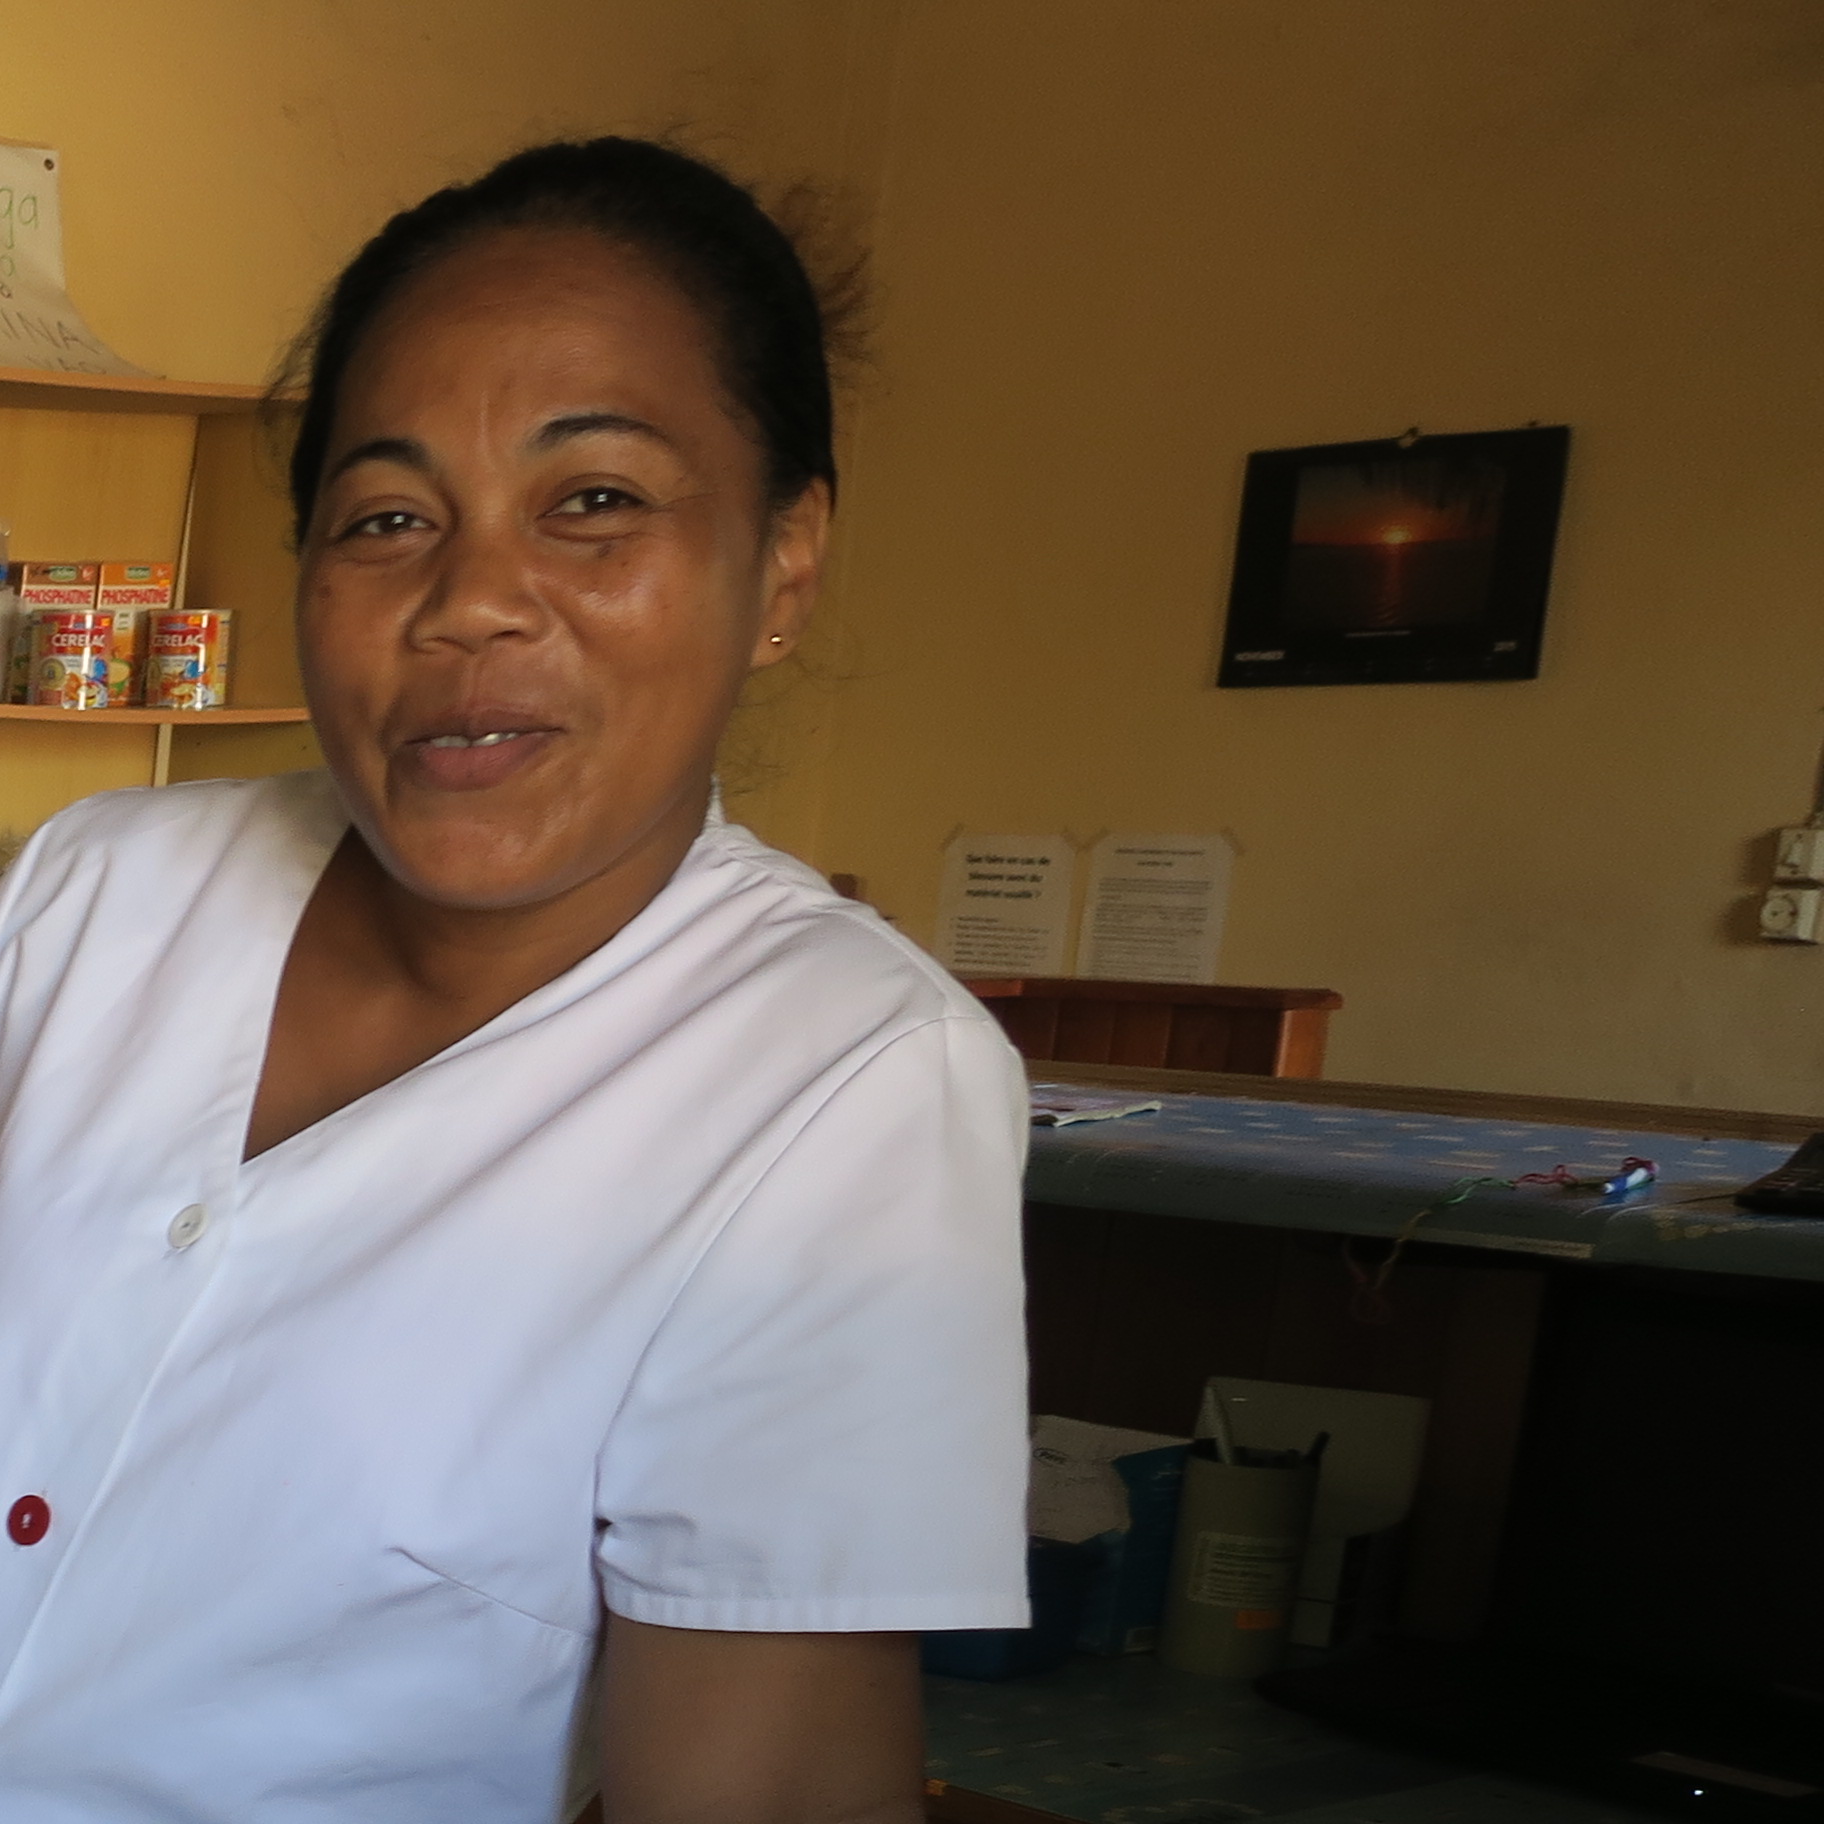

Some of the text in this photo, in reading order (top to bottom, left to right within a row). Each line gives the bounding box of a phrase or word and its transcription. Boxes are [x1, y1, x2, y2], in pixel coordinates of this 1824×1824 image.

[24, 589, 95, 605] PHOSPHATINE
[102, 587, 170, 605] PHOSPHATINE
[53, 634, 105, 647] CERELAC
